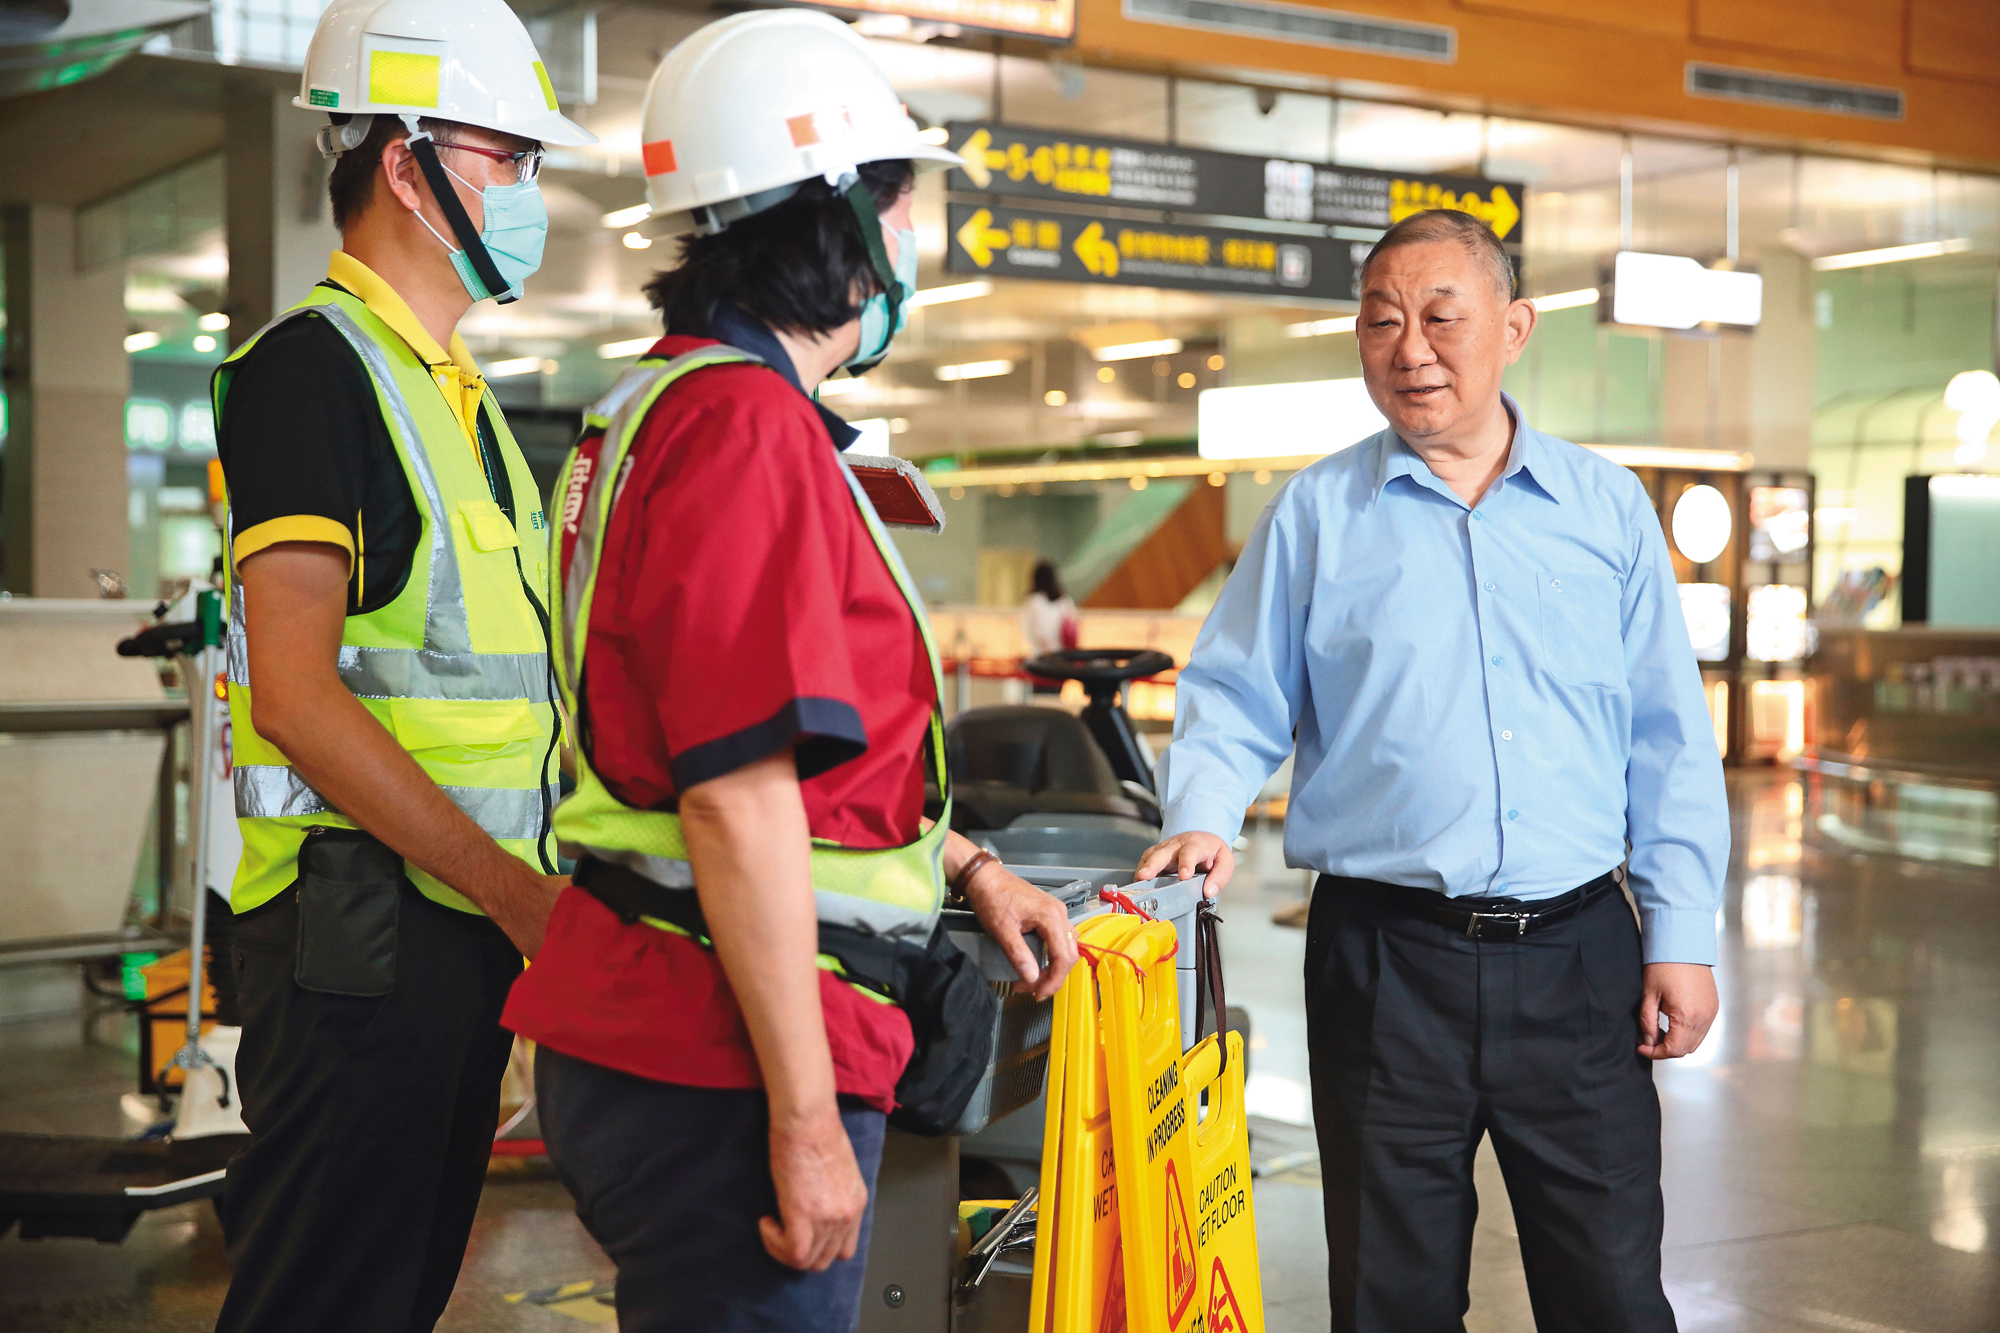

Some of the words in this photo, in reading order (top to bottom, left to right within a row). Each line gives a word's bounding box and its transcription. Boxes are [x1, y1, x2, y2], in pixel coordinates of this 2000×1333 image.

[1147, 1060, 1178, 1114] CLEANING
[1147, 1132, 1155, 1164] IN
[1154, 1097, 1185, 1156] PROGRESS
[1094, 1184, 1114, 1223] WET
[1199, 1161, 1237, 1214] CAUTION
[1212, 1189, 1245, 1235] FLOOR
